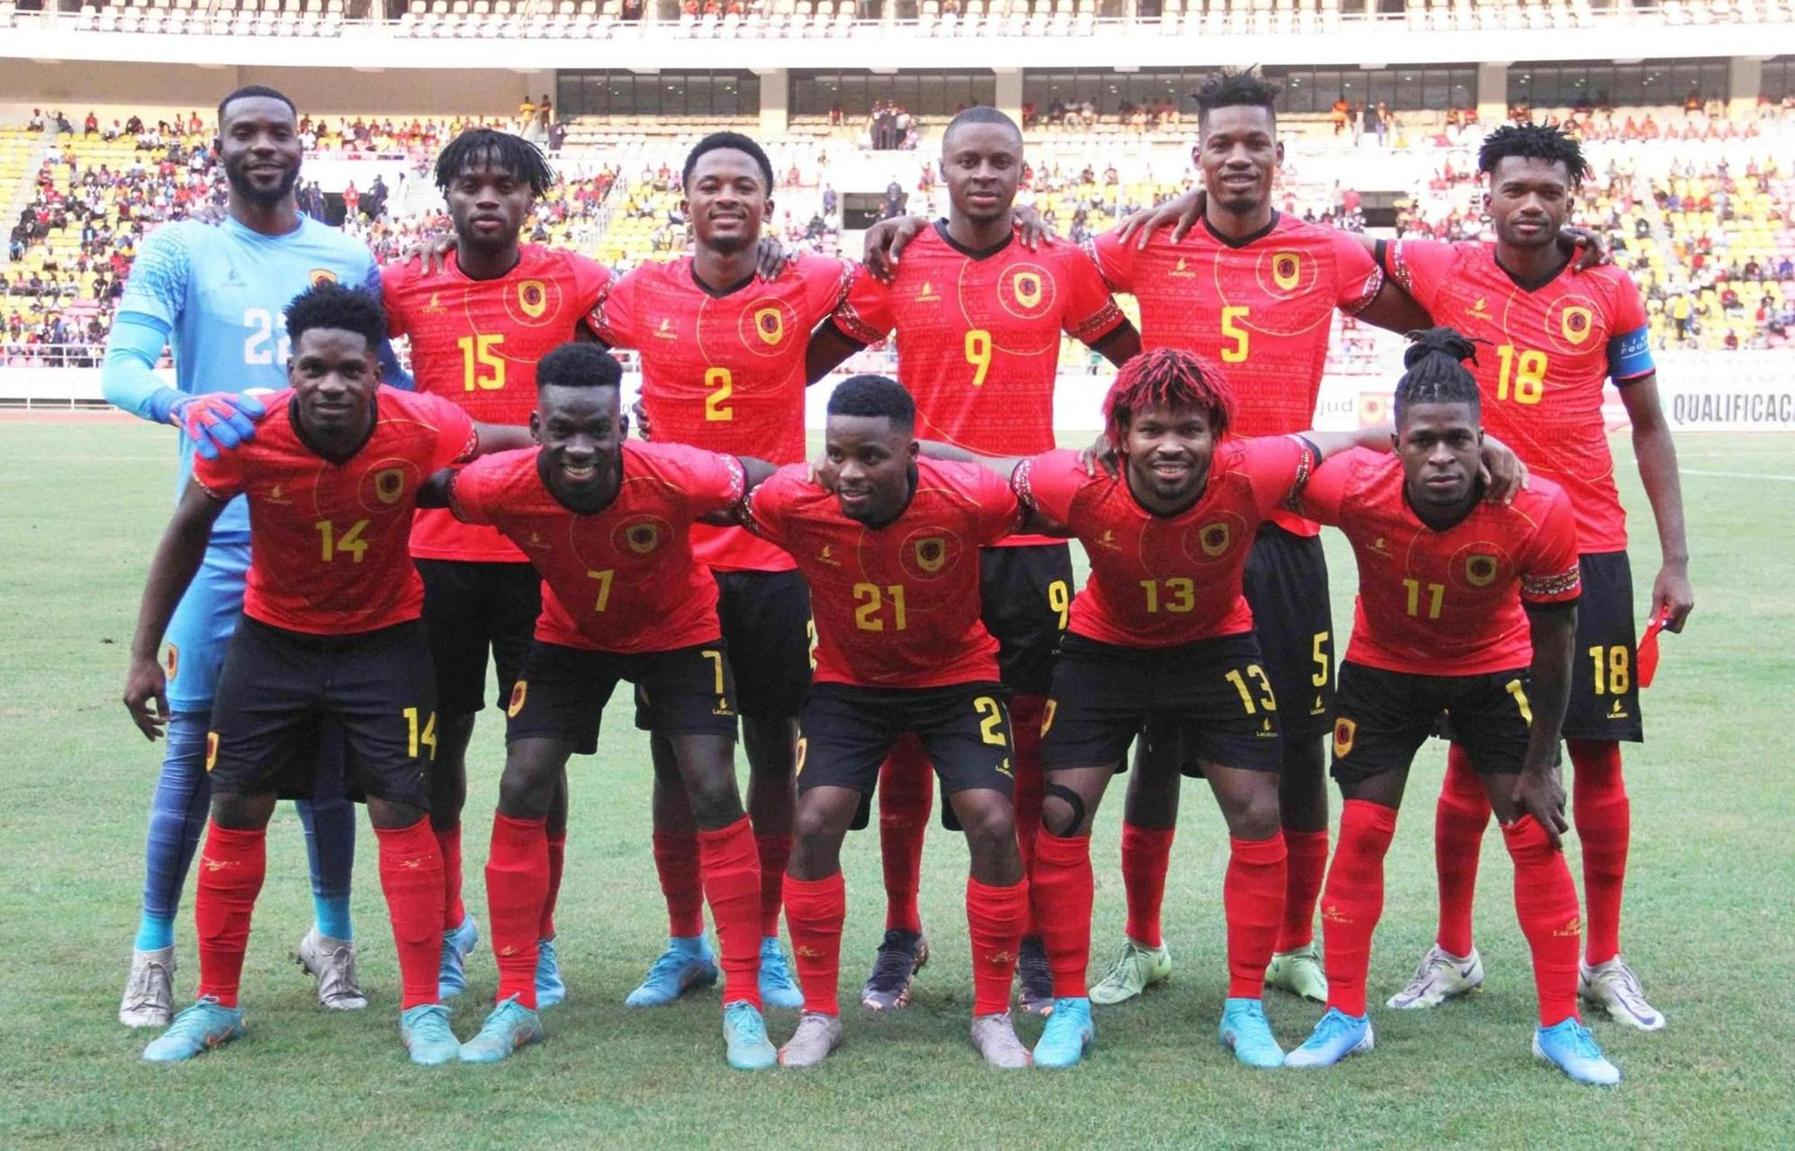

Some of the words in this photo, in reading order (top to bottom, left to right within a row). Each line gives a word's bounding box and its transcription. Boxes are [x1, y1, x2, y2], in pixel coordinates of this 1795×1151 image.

[964, 329, 993, 386] 9
[1220, 305, 1250, 364] 5
[457, 333, 506, 392] 15
[1497, 344, 1548, 405] 18
[704, 367, 733, 422] 2
[316, 519, 370, 563] 14
[587, 569, 614, 612] 7
[853, 582, 907, 631] 21
[1048, 579, 1069, 630] 9
[1141, 577, 1196, 613] 13
[1403, 578, 1445, 619] 11
[702, 650, 724, 694] 7
[1312, 631, 1329, 687] 5
[1588, 645, 1629, 695] 18
[1225, 666, 1276, 714] 13
[403, 707, 437, 761] 14
[974, 696, 1006, 746] 2
